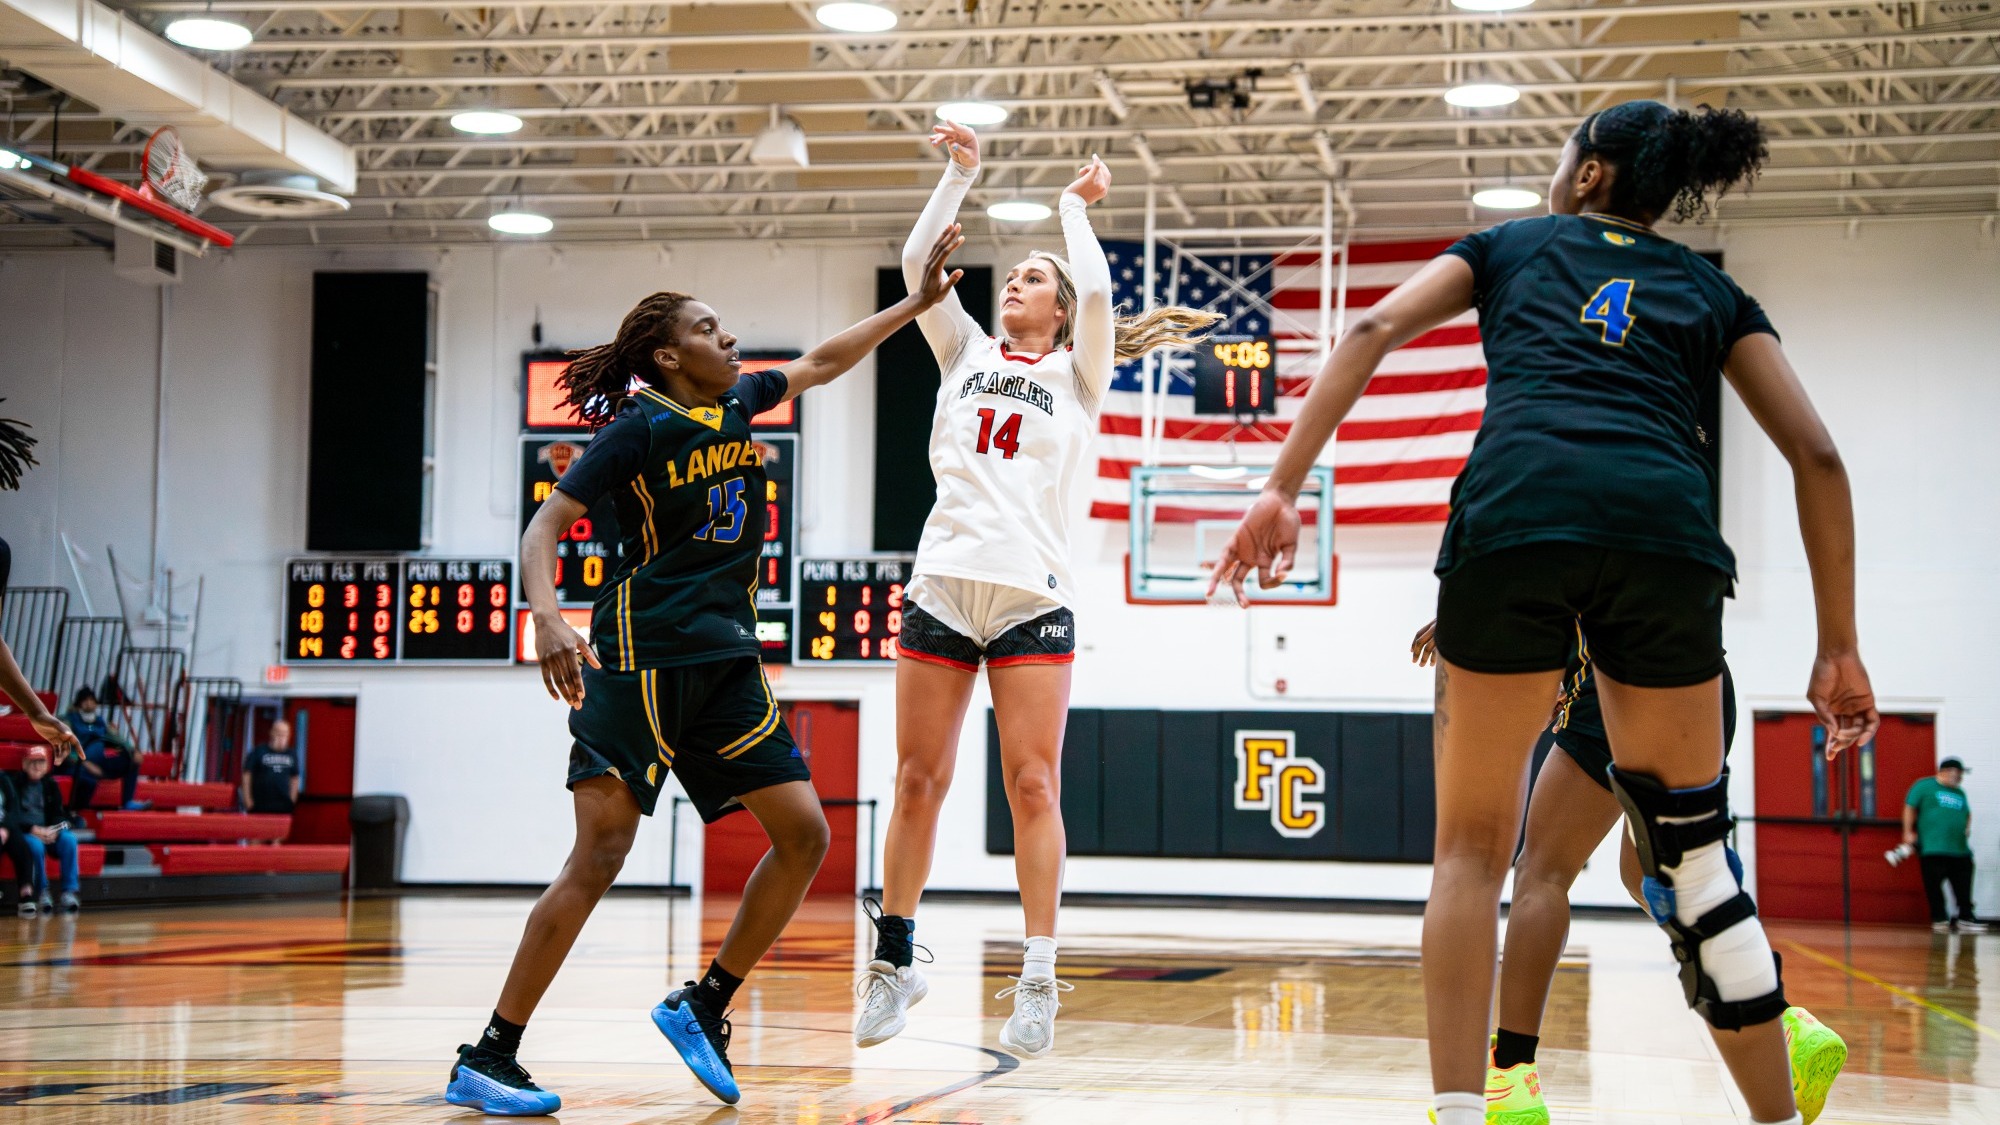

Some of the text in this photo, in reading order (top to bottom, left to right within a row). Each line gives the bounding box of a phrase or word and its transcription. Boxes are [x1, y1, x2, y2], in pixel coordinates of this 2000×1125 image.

[1580, 278, 1636, 346] 4
[1214, 341, 1271, 369] 4:06
[960, 372, 1053, 417] FLAGLER
[976, 408, 1023, 460] 14
[692, 476, 748, 543] 15
[408, 562, 505, 581] PLYR FLS PTS
[583, 556, 604, 587] 0
[308, 584, 391, 608] 0 3 3
[409, 584, 507, 608] 21 0 0
[827, 584, 903, 608] 1 1 2
[300, 609, 391, 634] 10 1 0
[408, 609, 440, 634] 25
[456, 609, 473, 634] 0
[819, 609, 902, 634] 4 0 0
[1040, 625, 1068, 638] PBC
[299, 635, 390, 659] 14 2 5
[811, 635, 836, 660] 12
[861, 637, 871, 658] 1
[1234, 730, 1326, 839] FC
